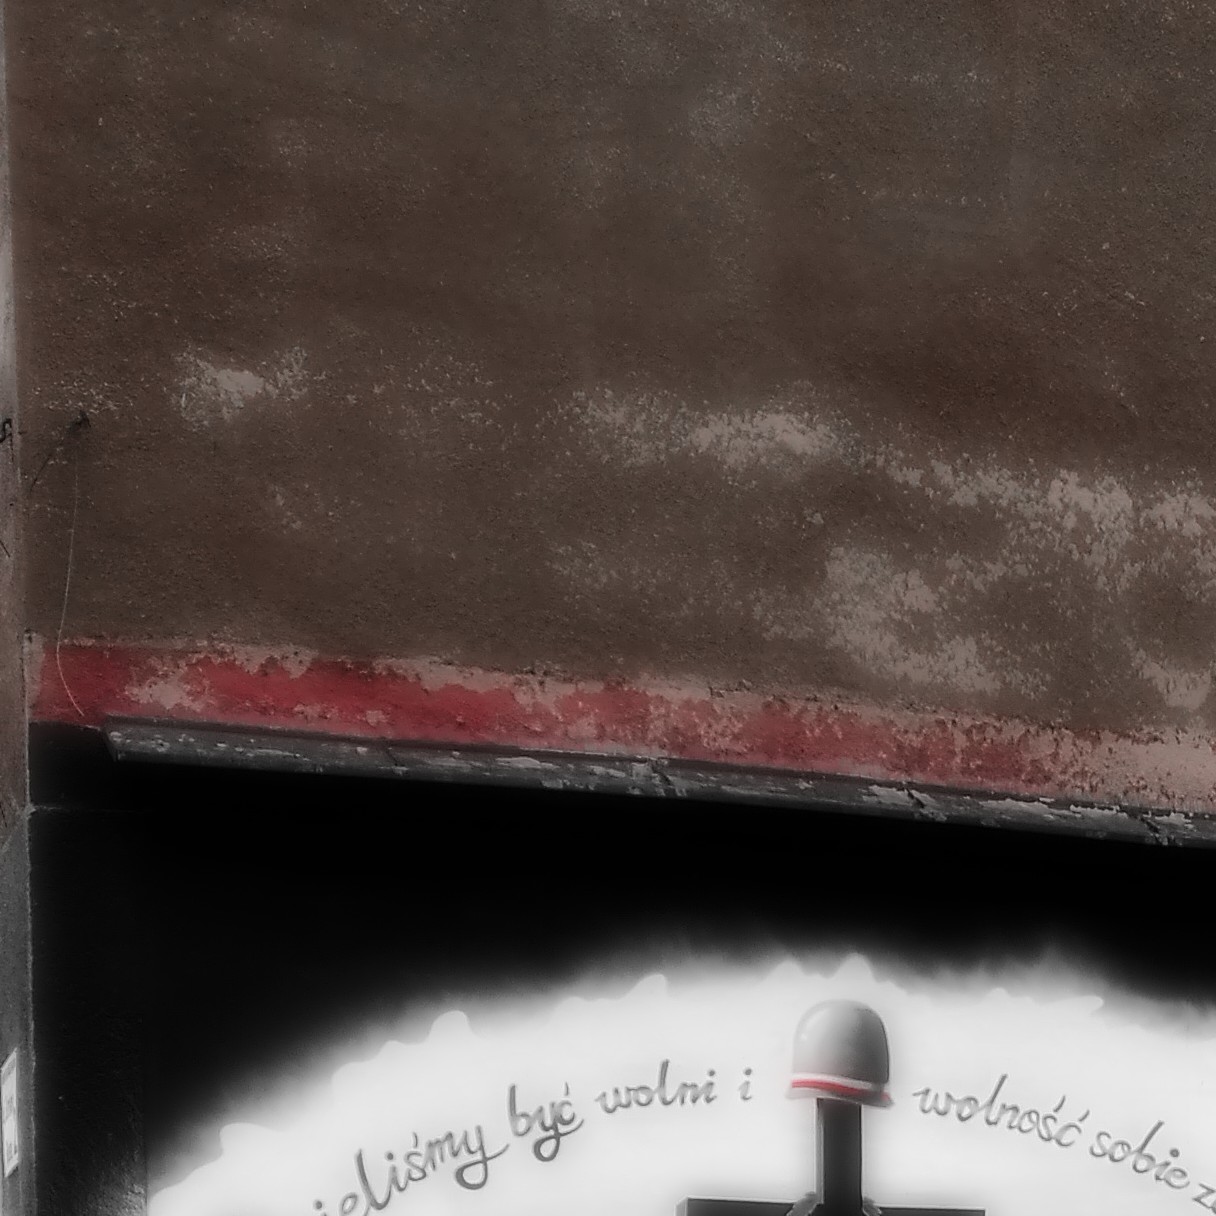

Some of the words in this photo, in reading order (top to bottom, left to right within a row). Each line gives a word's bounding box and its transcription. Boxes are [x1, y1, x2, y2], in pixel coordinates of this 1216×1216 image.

[507, 1082, 585, 1162] być
[595, 1058, 717, 1108] wolni
[737, 1066, 755, 1102] i
[912, 1073, 1091, 1150] wolność
[1089, 1119, 1190, 1191] sobie
